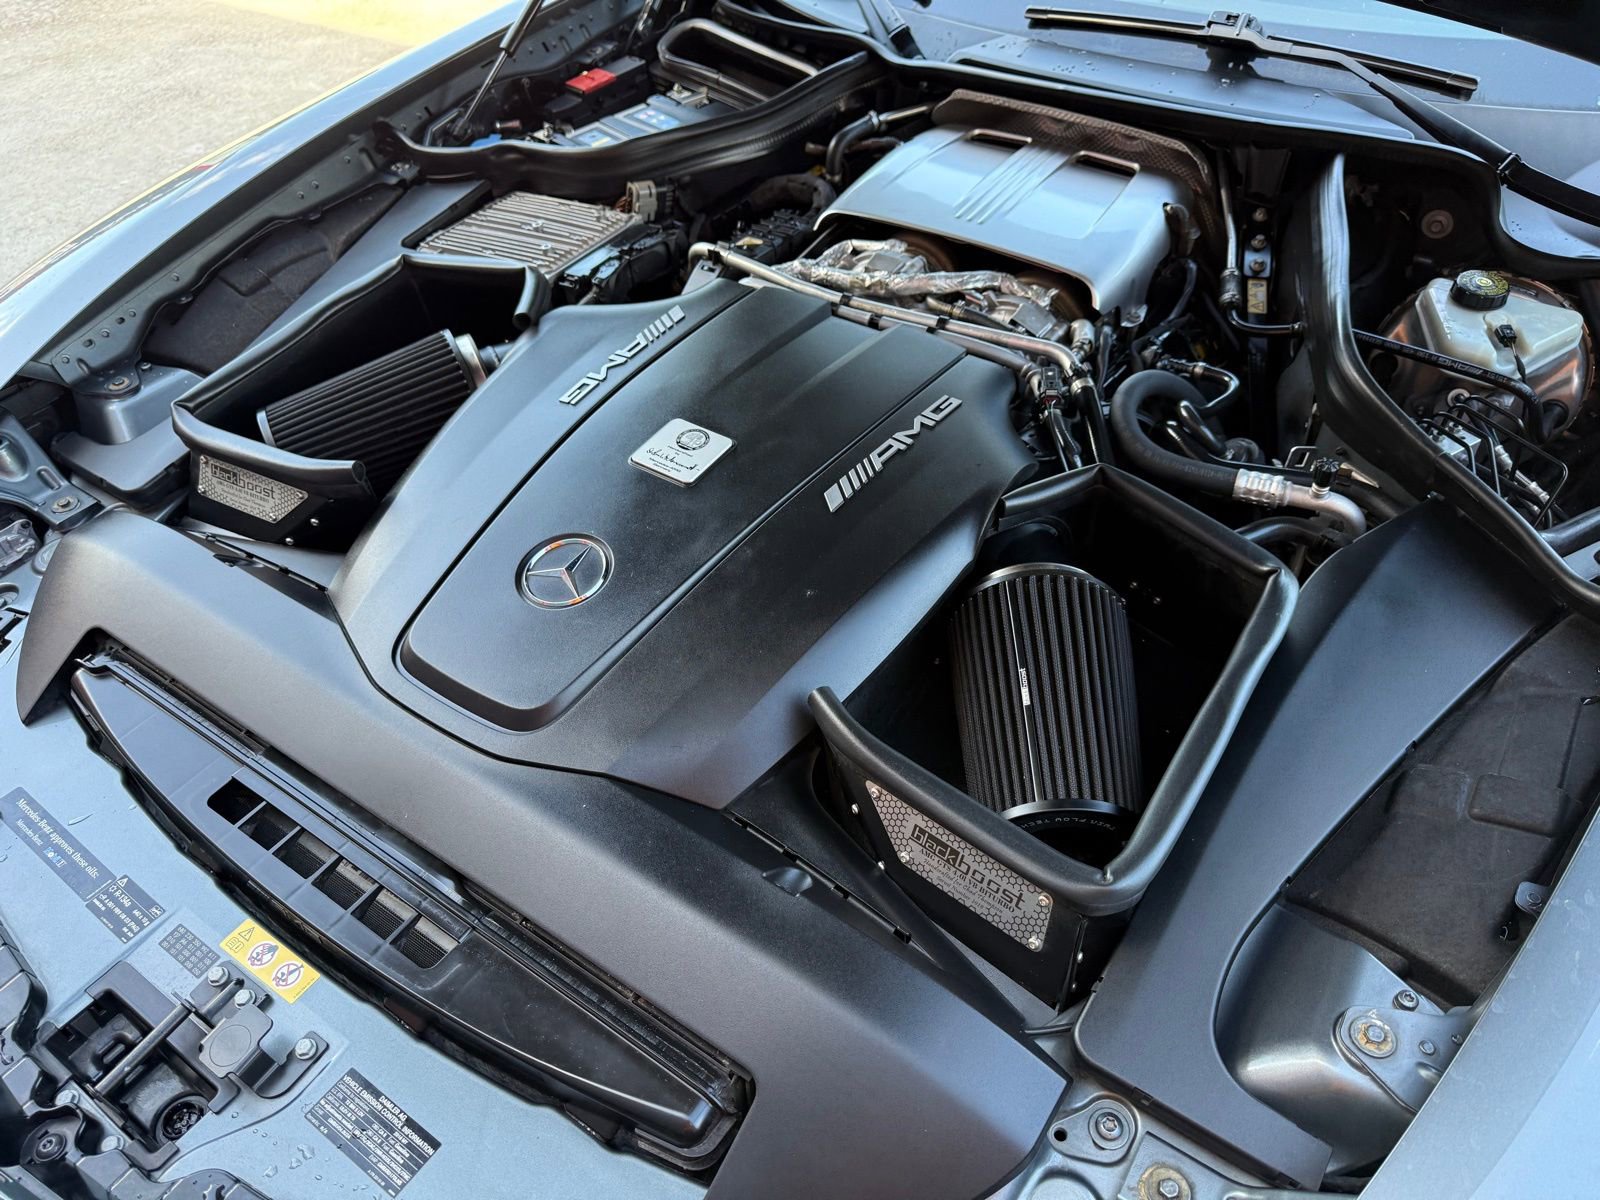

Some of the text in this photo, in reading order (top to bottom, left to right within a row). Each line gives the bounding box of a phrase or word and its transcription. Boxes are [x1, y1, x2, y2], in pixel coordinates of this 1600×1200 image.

[559, 332, 649, 405] AMG
[869, 394, 963, 472] AMG
[210, 463, 275, 500] blackboost
[15, 798, 99, 879] Mercedes-Benz approves these oils:
[911, 824, 1026, 910] blackboost
[922, 858, 955, 882] Handcrafted
[919, 848, 937, 862] AMG
[935, 858, 952, 872] GTS
[979, 887, 1016, 914] BITURBO
[342, 1074, 435, 1156] VEHICLE EMISSION CONTROL INFORMATION
[378, 1095, 408, 1121] DAIMLER AG
